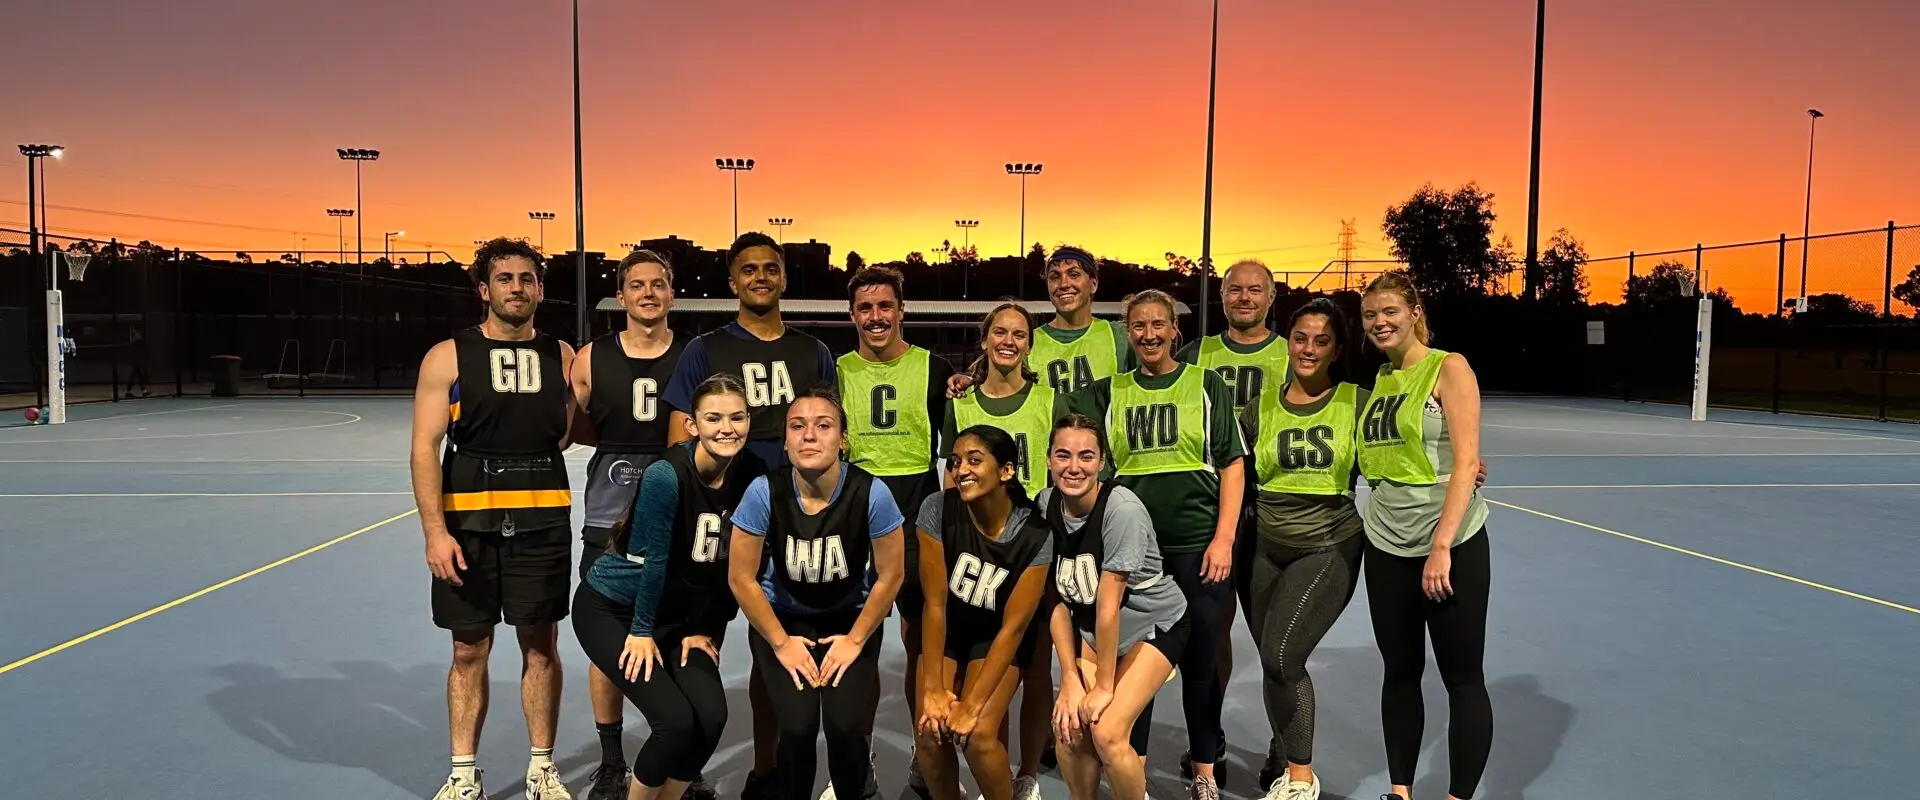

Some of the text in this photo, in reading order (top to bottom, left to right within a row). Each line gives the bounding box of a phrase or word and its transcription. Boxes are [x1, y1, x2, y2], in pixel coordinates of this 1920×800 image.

[490, 348, 541, 393] GD
[742, 360, 795, 407] GA
[1047, 355, 1095, 394] GA
[1214, 365, 1264, 407] GD
[633, 378, 657, 422] C
[871, 384, 897, 430] C
[1362, 392, 1409, 443] GK
[1125, 403, 1179, 450] WD
[1277, 424, 1335, 470] GS
[620, 466, 645, 475] HOTCH
[1014, 432, 1030, 481] A
[785, 534, 849, 583] WA
[950, 552, 1010, 611] GK
